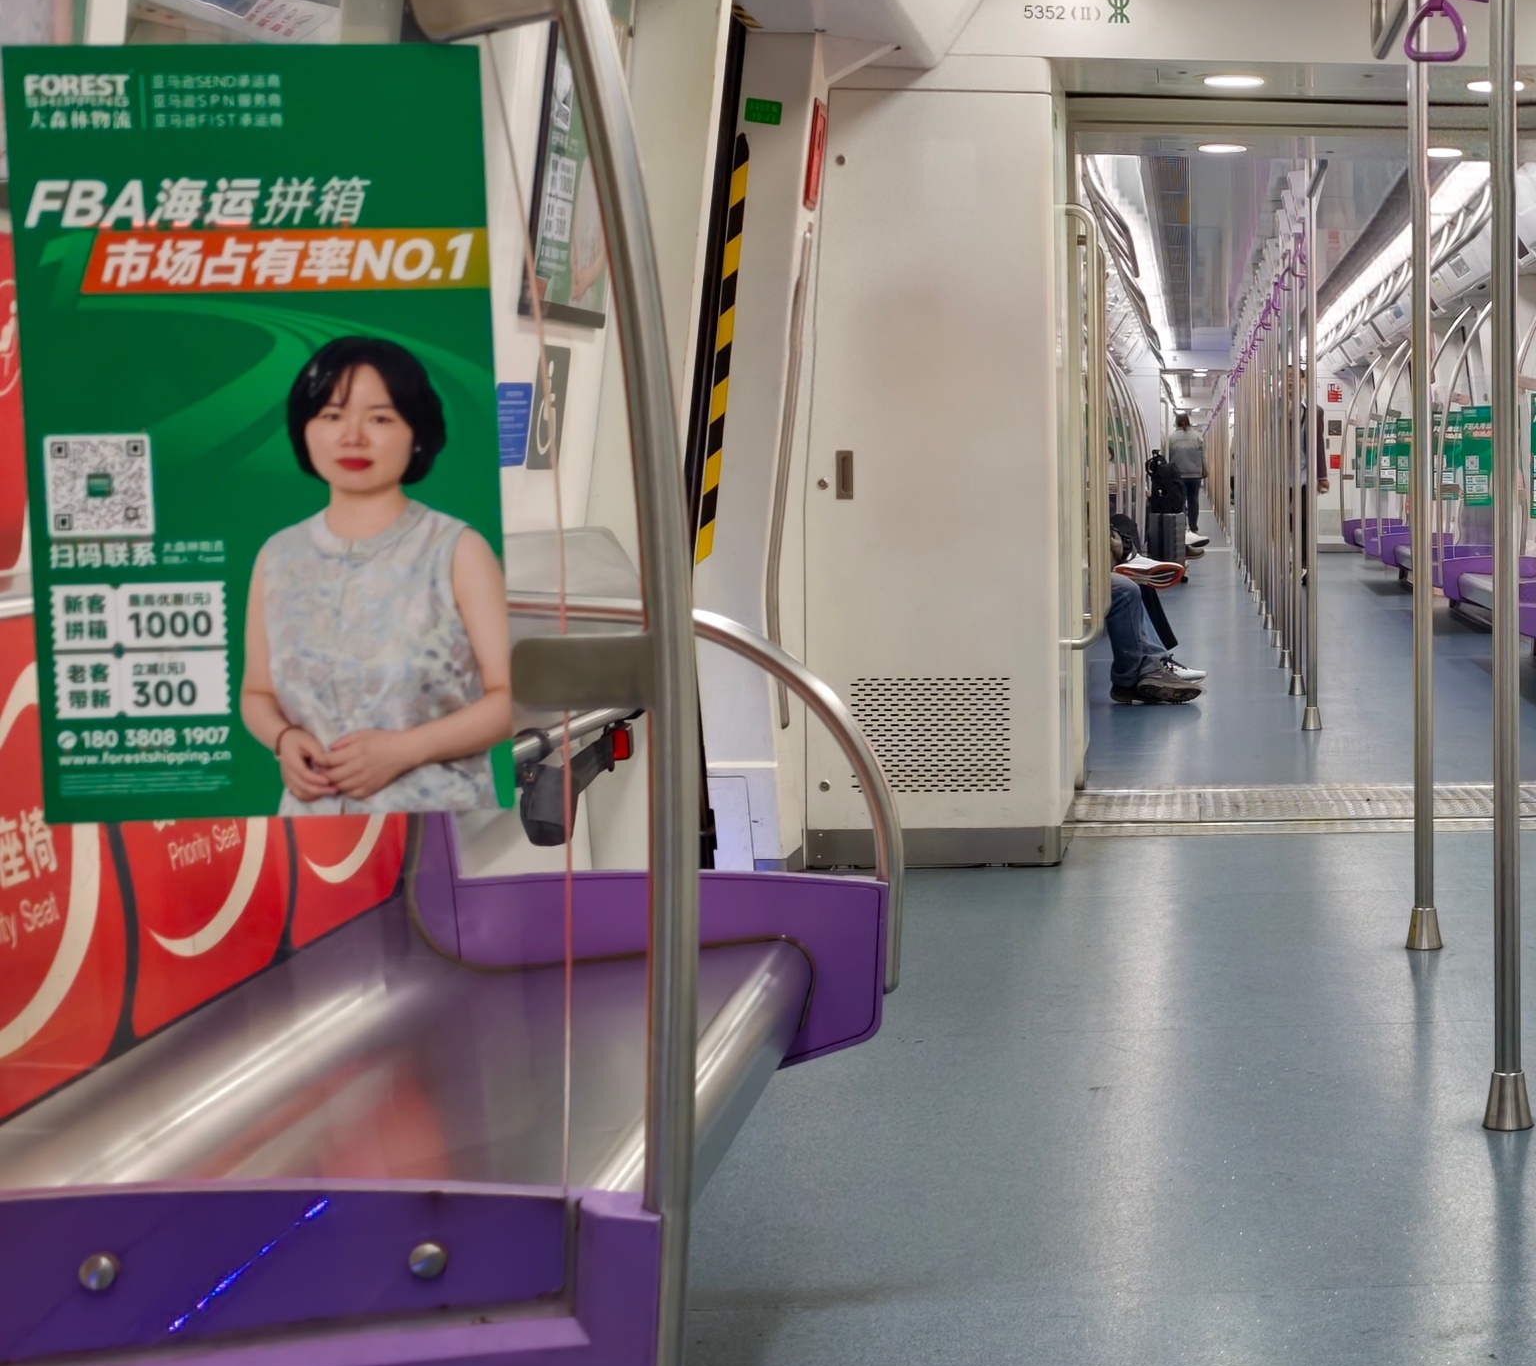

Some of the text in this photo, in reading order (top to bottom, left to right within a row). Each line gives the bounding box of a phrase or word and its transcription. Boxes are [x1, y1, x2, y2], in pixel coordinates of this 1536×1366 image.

[1023, 4, 1066, 20] 5352
[23, 73, 130, 97] FOREST
[25, 96, 130, 108] SHIPPING
[30, 109, 132, 130] 大森林物流
[24, 176, 372, 229] FBA海运拼箱
[101, 233, 475, 287] 市场占有率NO.1
[50, 541, 157, 569] 扫码联系
[63, 594, 106, 616] 新客
[65, 619, 107, 642] 拼箱
[128, 610, 213, 640] 1000
[67, 662, 110, 684] 老客
[68, 689, 112, 710] 带新
[132, 679, 198, 709] 300
[80, 725, 231, 750] 180 3808 1907
[58, 747, 233, 767] www.forestshipping.cn
[0, 806, 58, 890] 座椅
[167, 818, 242, 872] Priority Seat
[20, 891, 61, 933] Seat
